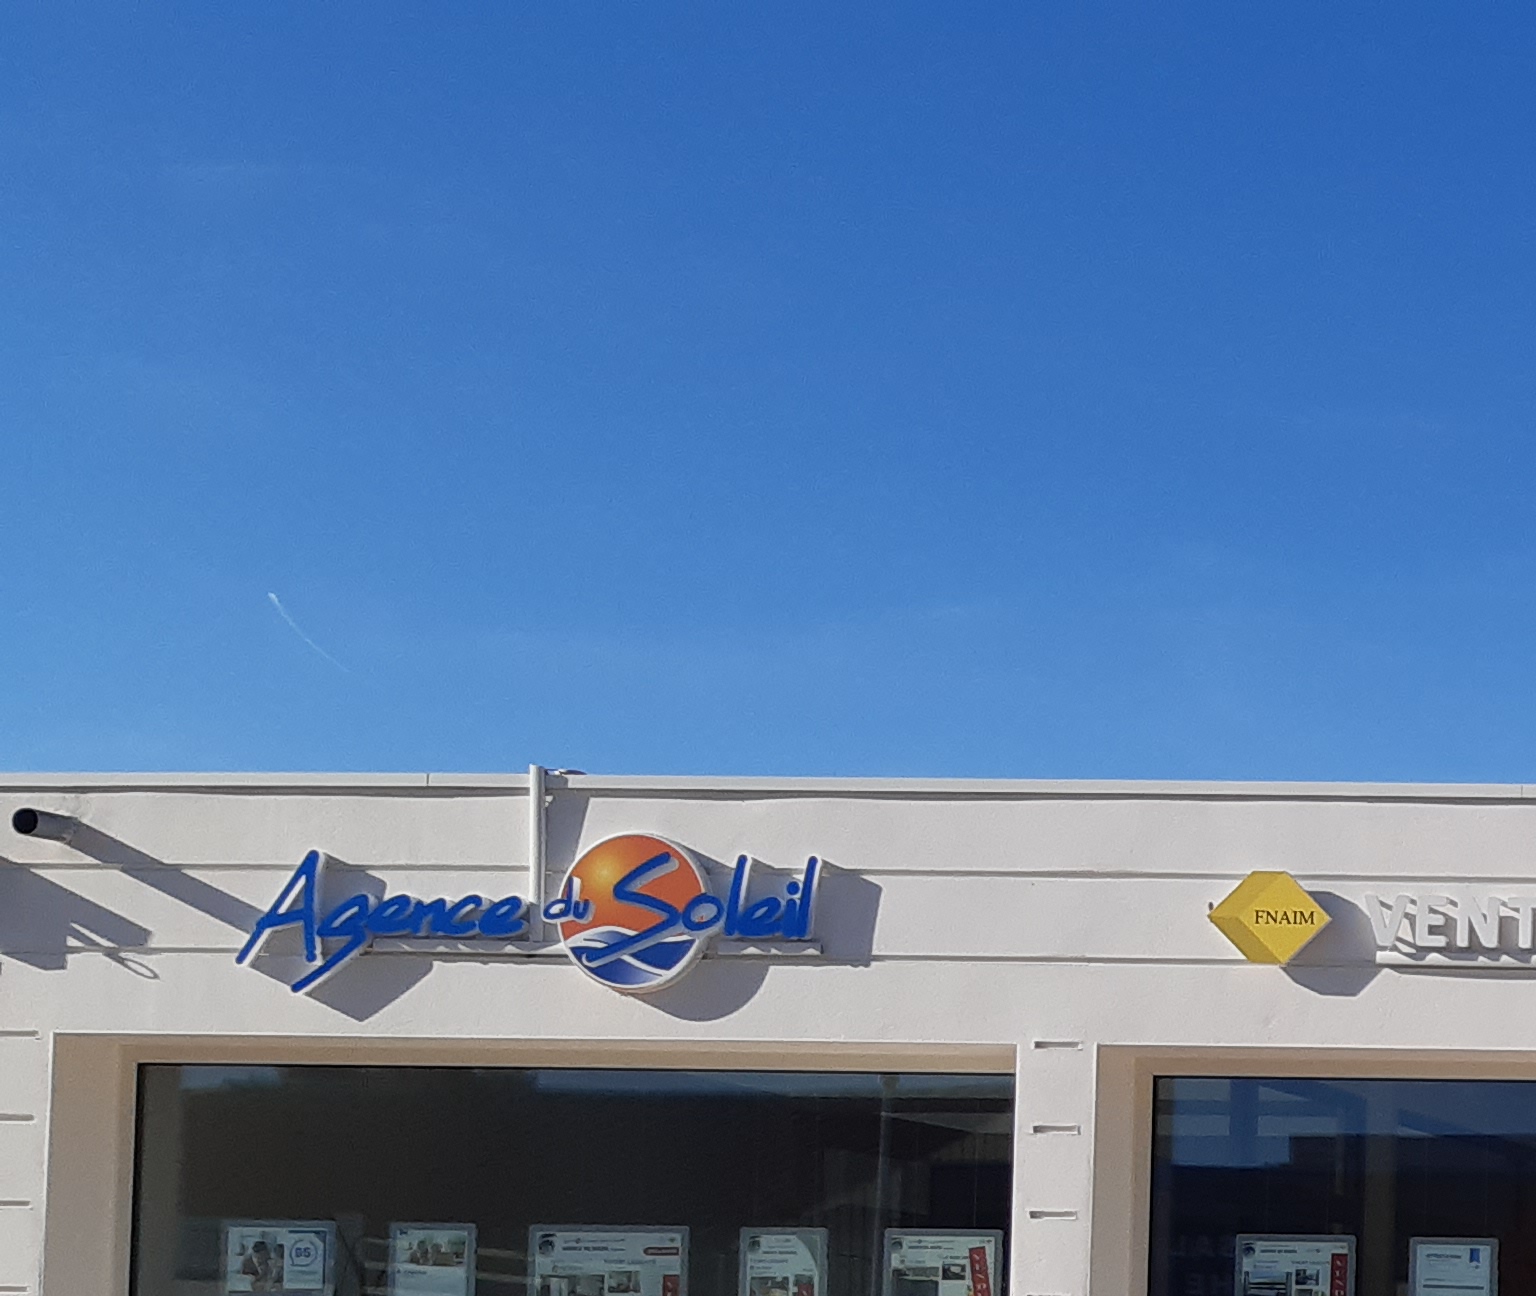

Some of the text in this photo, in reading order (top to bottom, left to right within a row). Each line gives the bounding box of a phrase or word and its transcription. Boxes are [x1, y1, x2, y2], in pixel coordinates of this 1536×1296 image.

[236, 850, 819, 994] Agence du Soleil
[1254, 909, 1316, 926] FNAIM
